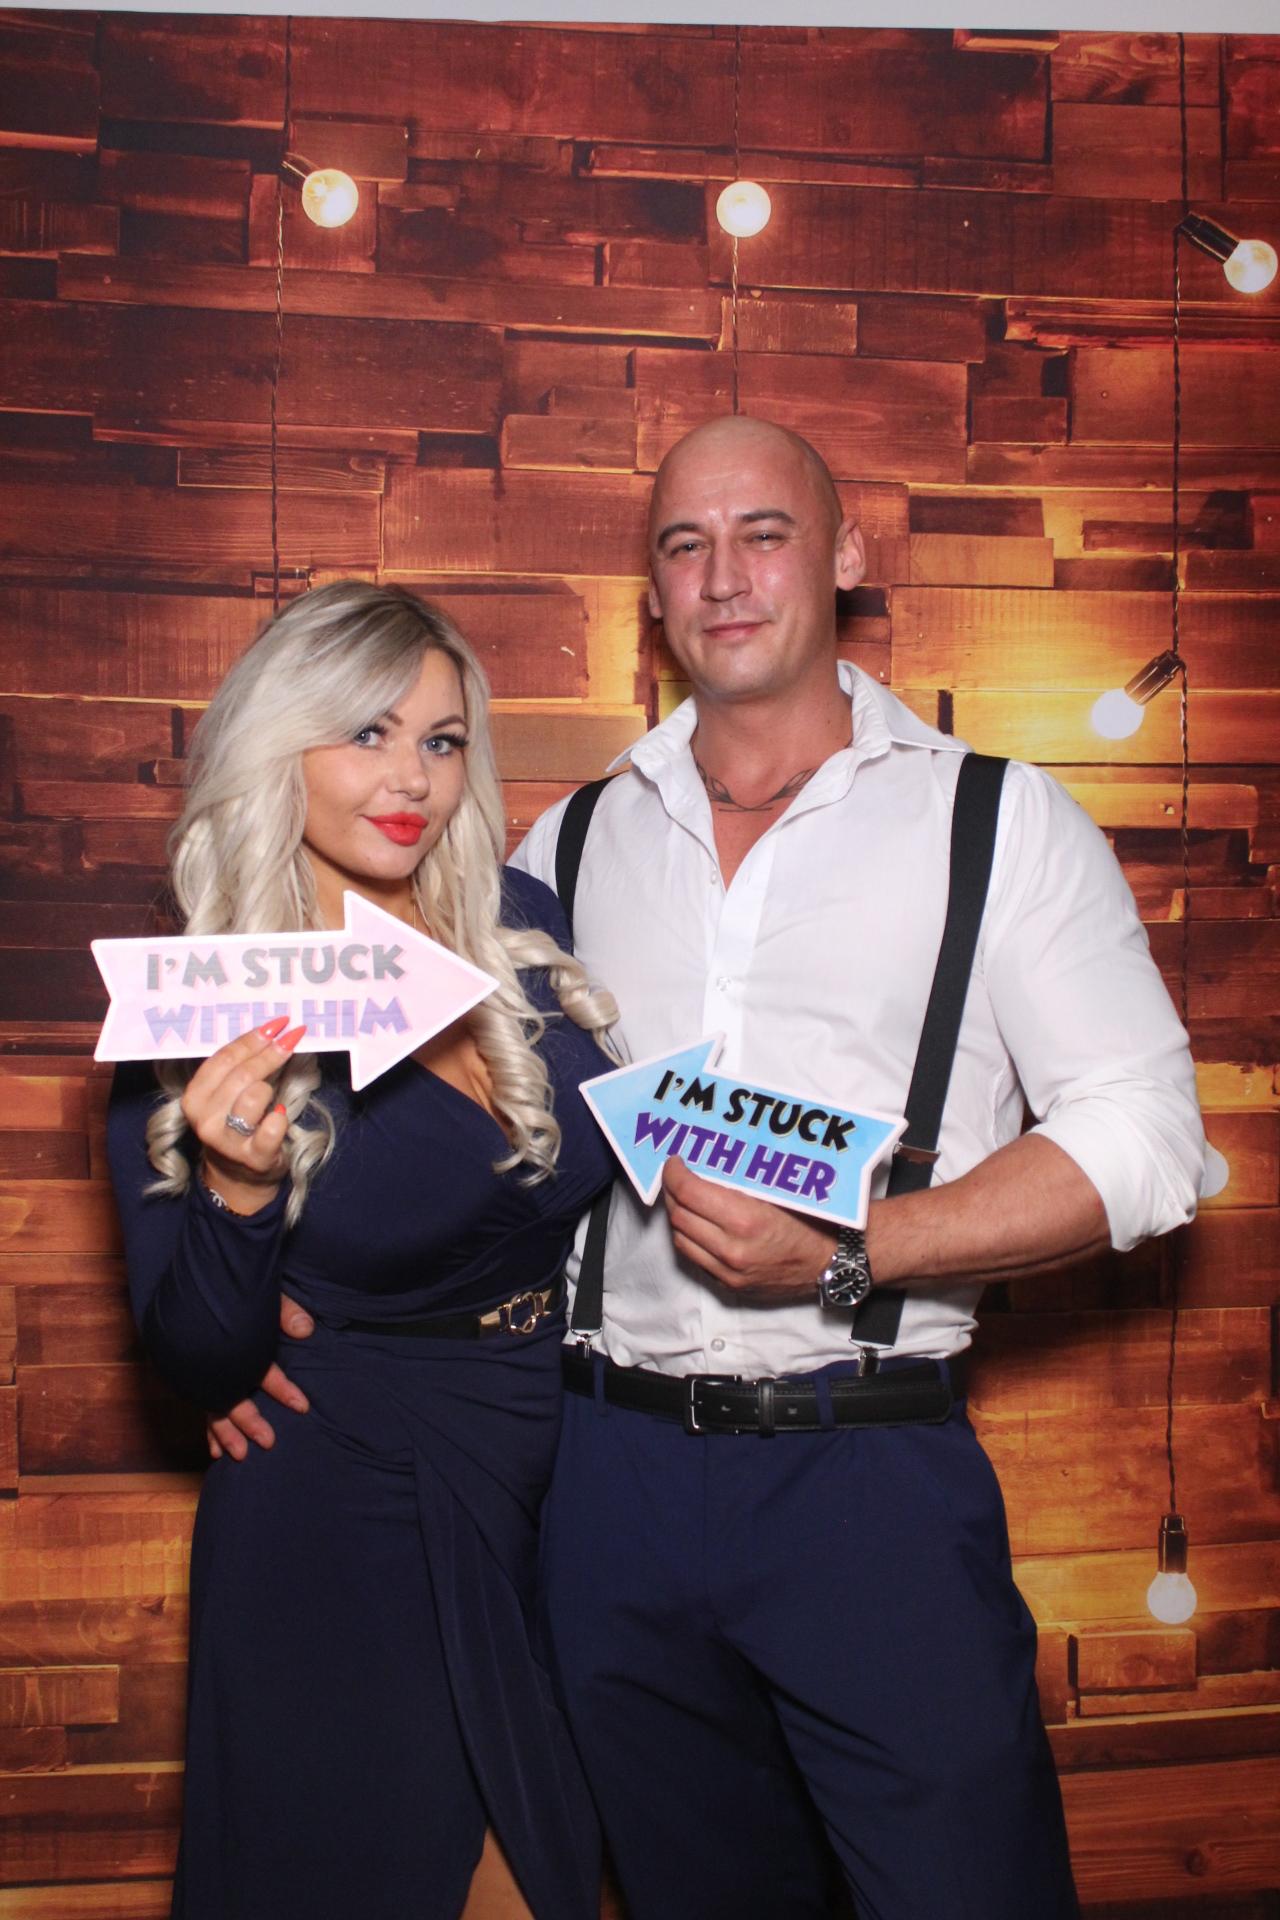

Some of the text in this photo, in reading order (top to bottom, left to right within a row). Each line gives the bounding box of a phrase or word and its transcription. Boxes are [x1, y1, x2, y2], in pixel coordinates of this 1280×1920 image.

[147, 944, 405, 990] I'M STUCK
[302, 996, 413, 1038] HIM
[653, 1070, 856, 1152] I'M STUCK
[633, 1112, 837, 1203] WITH HER
